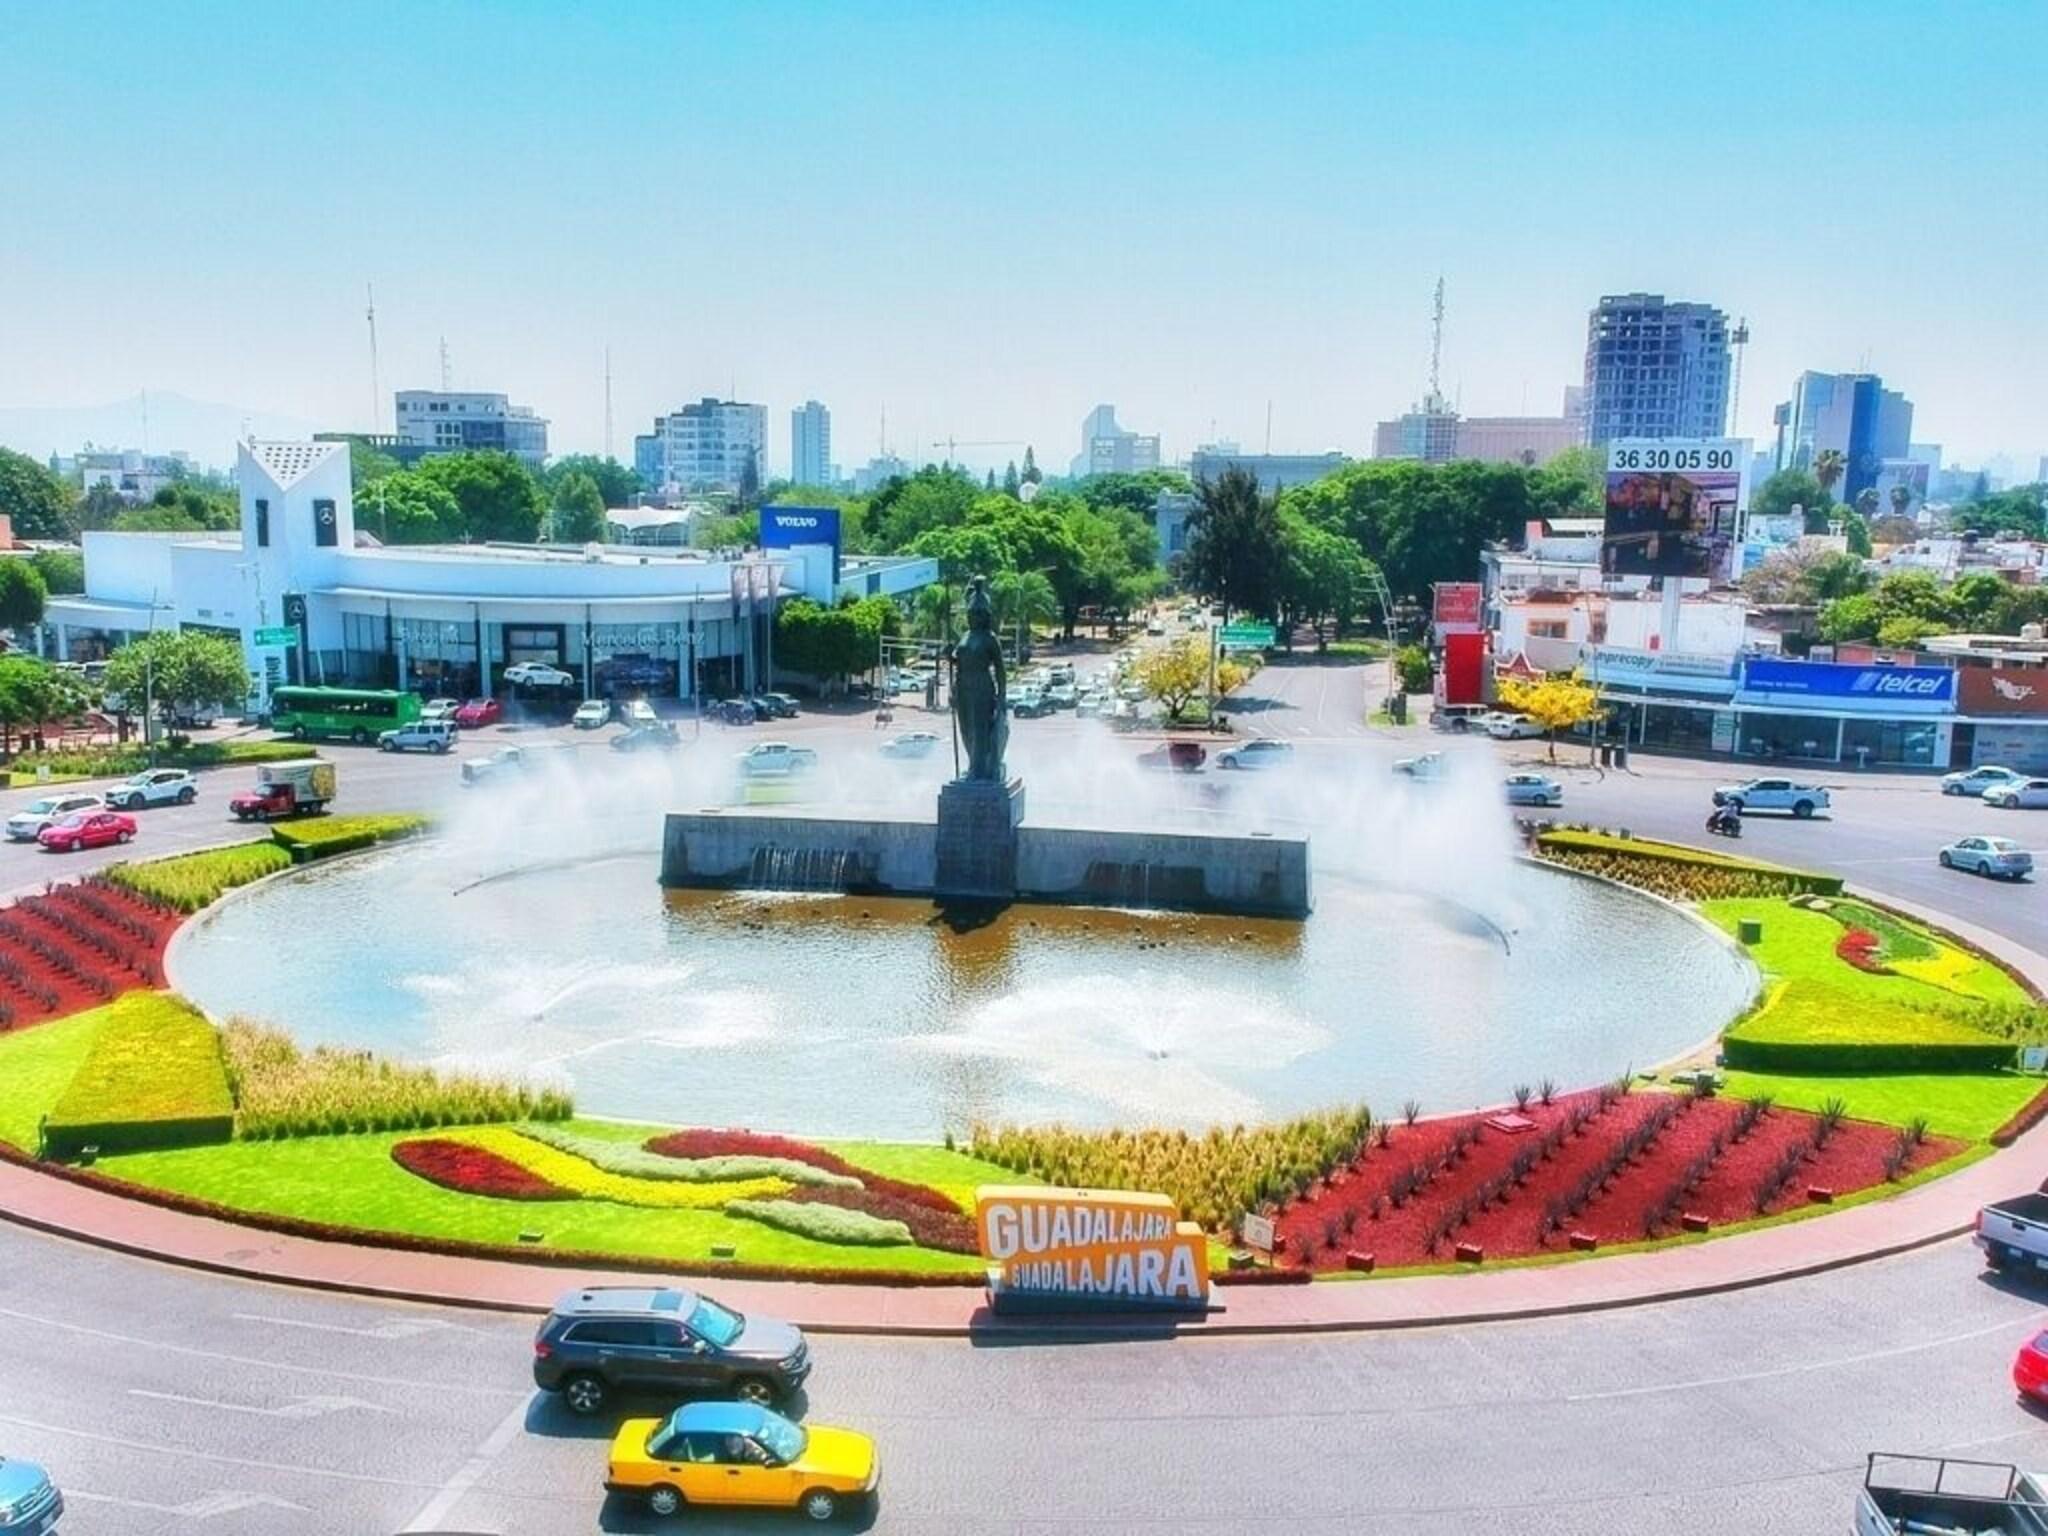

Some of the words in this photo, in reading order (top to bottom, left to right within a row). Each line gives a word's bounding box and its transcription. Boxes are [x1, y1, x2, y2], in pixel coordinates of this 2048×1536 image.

[1615, 450, 1640, 468] 36
[1645, 450, 1670, 468] 30
[1675, 450, 1701, 468] 05
[1707, 450, 1733, 468] 90
[775, 515, 817, 528] VOLVO
[1875, 673, 1945, 693] telcel
[986, 1204, 1171, 1260] GUADALAJARA
[1012, 1244, 1201, 1297] GUADALAJARA
